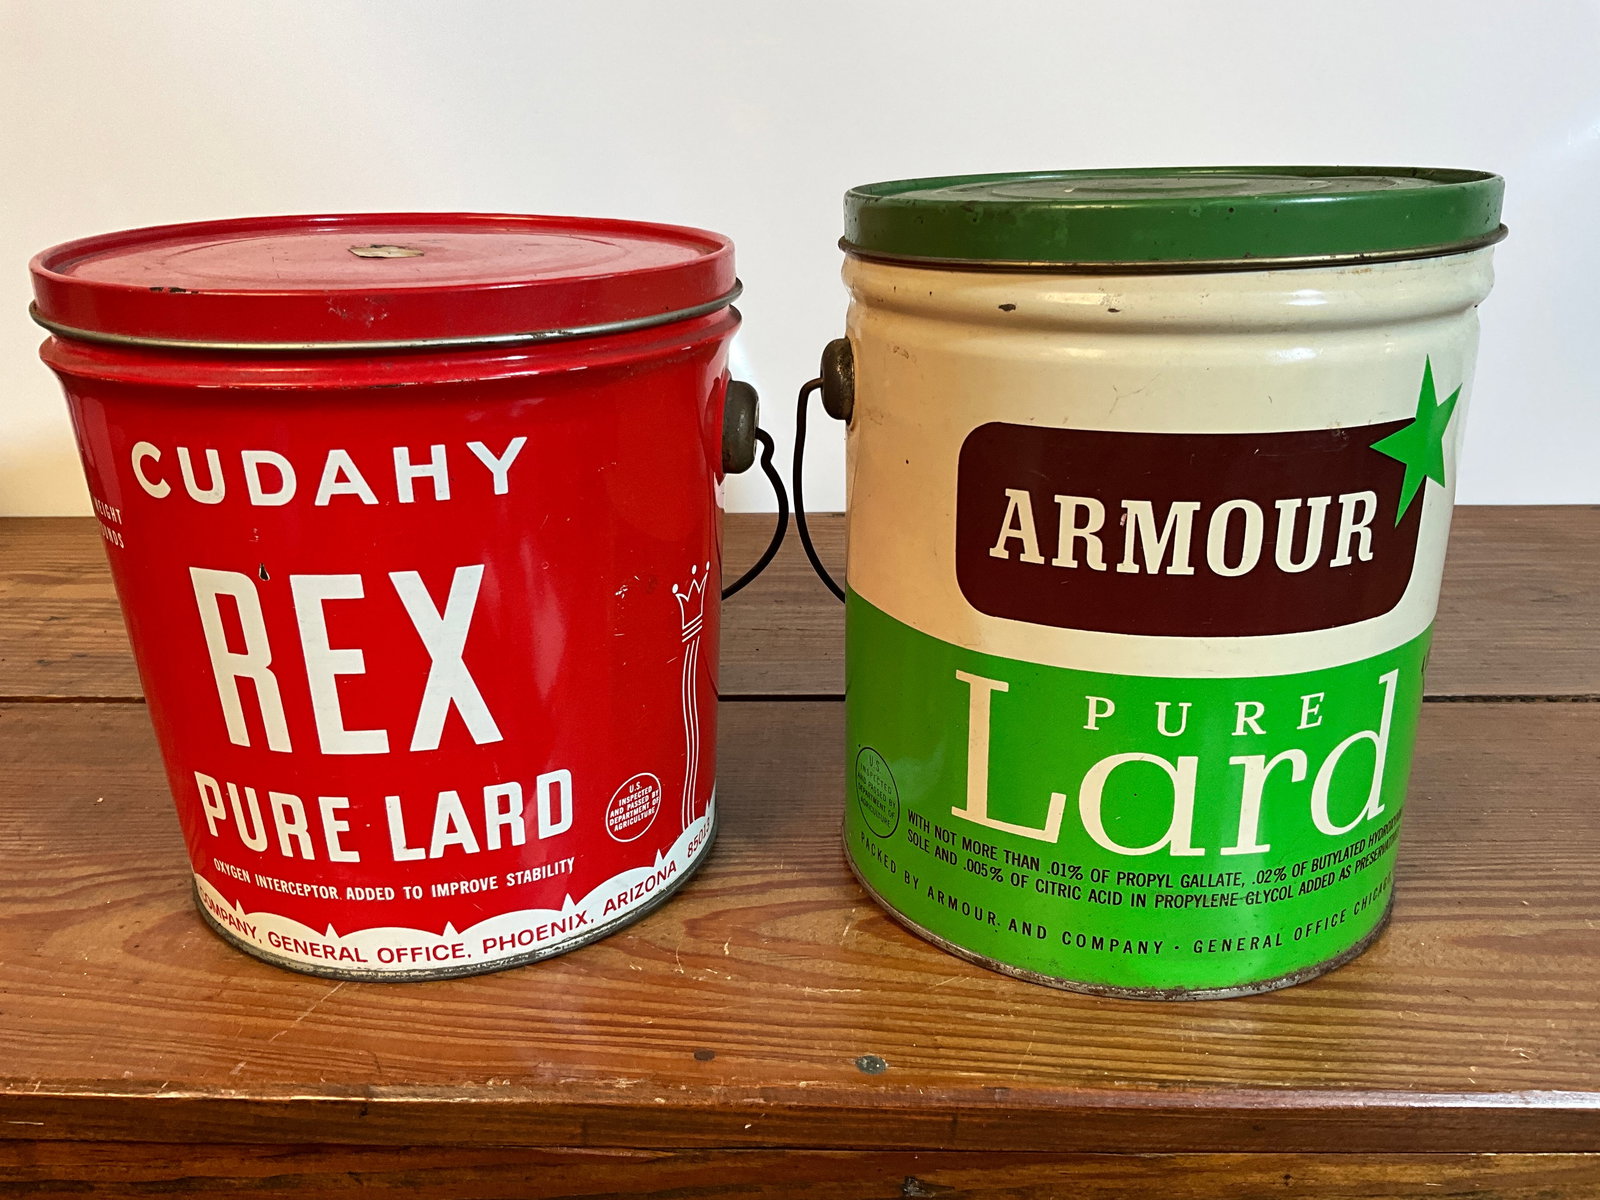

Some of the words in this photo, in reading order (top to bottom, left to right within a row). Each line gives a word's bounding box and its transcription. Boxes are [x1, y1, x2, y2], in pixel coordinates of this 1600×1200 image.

[131, 436, 528, 507] CUDAHY
[989, 488, 1378, 577] ARMOUR
[188, 563, 504, 756] REX
[1083, 692, 1325, 738] PURE
[618, 785, 653, 806] INSPECTED
[629, 781, 642, 793] U.S.
[950, 668, 1399, 857] Lard
[193, 770, 361, 862] PURE
[385, 768, 574, 862] LARD
[609, 802, 650, 826] DEPARTMENT
[652, 796, 660, 806] OF
[610, 807, 624, 818] AND
[627, 795, 650, 811] PASSED
[652, 789, 660, 799] BY
[614, 806, 656, 832] AGRICULTURE
[213, 858, 250, 884] OXYGEN
[255, 873, 338, 900] INTERCEPTOR
[346, 887, 395, 900] ADDED
[403, 886, 423, 900] TO
[431, 876, 499, 898] IMPROVE
[506, 857, 575, 887] STABILITY
[907, 809, 931, 834] WITH
[934, 825, 957, 846] NOT
[961, 836, 998, 861] MORE
[1003, 849, 1040, 872] THAN
[1047, 861, 1084, 881] .01%
[1090, 868, 1111, 884] OF
[1116, 871, 1174, 888] PROPYL
[1180, 871, 1245, 888] GALLATE,
[1251, 866, 1287, 885] .02%
[1291, 861, 1308, 878] OF
[1311, 838, 1366, 873] BUTYLATED
[907, 829, 930, 853] SOLE
[934, 845, 957, 866] AND
[963, 858, 1004, 883] .005%
[1010, 872, 1030, 888] OF
[1035, 878, 1081, 900] CITRIC
[1088, 888, 1123, 906] ACID
[1130, 893, 1146, 908] IN
[1154, 892, 1239, 909] PROPYLENE
[1245, 885, 1294, 905] GLYCOL
[1298, 872, 1335, 896] ADDED
[1338, 865, 1352, 881] AS
[268, 931, 368, 963] GENERAL
[603, 860, 677, 916] ARIZONA
[861, 831, 896, 874] PACKED
[904, 870, 919, 890] BY
[927, 886, 997, 926] ARMOUR
[1008, 918, 1047, 939] AND
[1062, 931, 1163, 955] COMPANY
[1193, 933, 1282, 953] GENERAL
[1294, 909, 1346, 941] OFFICE
